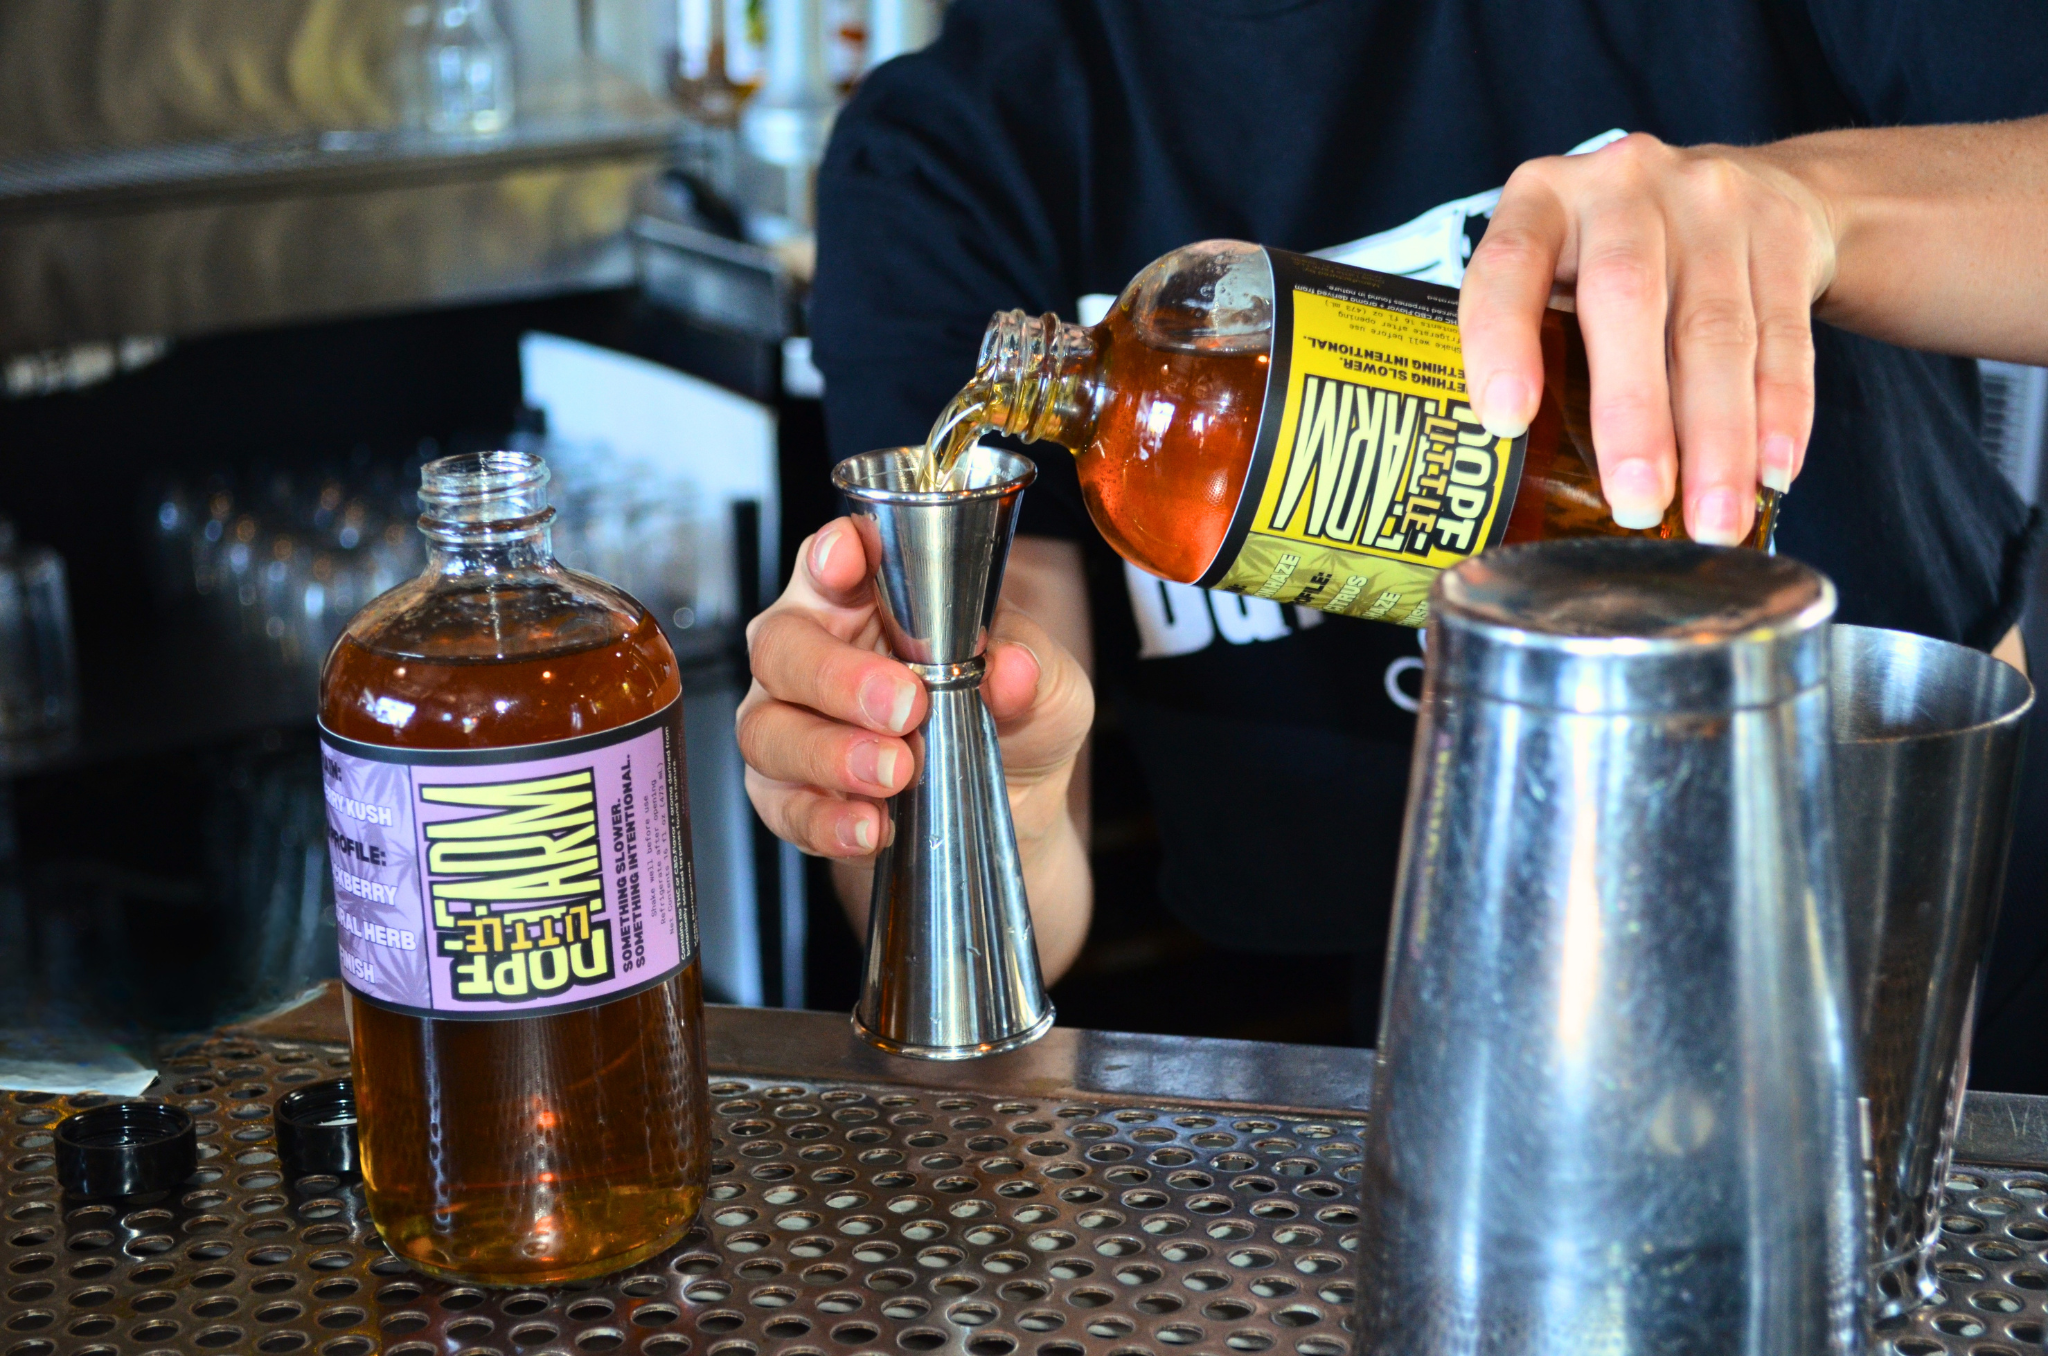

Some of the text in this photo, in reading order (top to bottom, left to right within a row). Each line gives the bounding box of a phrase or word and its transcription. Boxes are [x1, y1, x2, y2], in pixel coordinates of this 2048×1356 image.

[1294, 283, 1315, 294] from
[1316, 289, 1349, 301] derived
[1326, 285, 1356, 295] nature.
[1350, 298, 1378, 307] aroma
[1367, 293, 1391, 304] found
[1394, 300, 1430, 312] terpenes
[1373, 310, 1383, 318] oz
[1431, 308, 1459, 318] ourced
[1445, 318, 1459, 326] HC
[1338, 311, 1461, 345] frigerate after opening
[1349, 323, 1366, 332] use
[1370, 328, 1404, 342] before
[1420, 320, 1459, 334] ontents
[1409, 336, 1430, 346] well
[1303, 335, 1465, 380] ETHING INTENTIONAL.
[1339, 356, 1468, 394] ETHING SLOWER.
[345, 798, 394, 828] KUSH
[661, 813, 667, 826] oz
[645, 818, 653, 854] before
[676, 829, 684, 870] terpenes
[620, 754, 646, 969] SOMETHING INTENTIONAL.
[646, 859, 654, 883] well
[610, 797, 634, 974] SOMETHING SLOWER.
[665, 865, 673, 912] Contents
[675, 877, 680, 887] or
[679, 870, 687, 906] sourced
[658, 860, 667, 925] Refrigerate
[650, 887, 658, 918] Shake
[677, 908, 683, 920] no
[337, 903, 417, 952] RAL HERB
[457, 905, 591, 953] LITTLE
[678, 921, 686, 961] Contains
